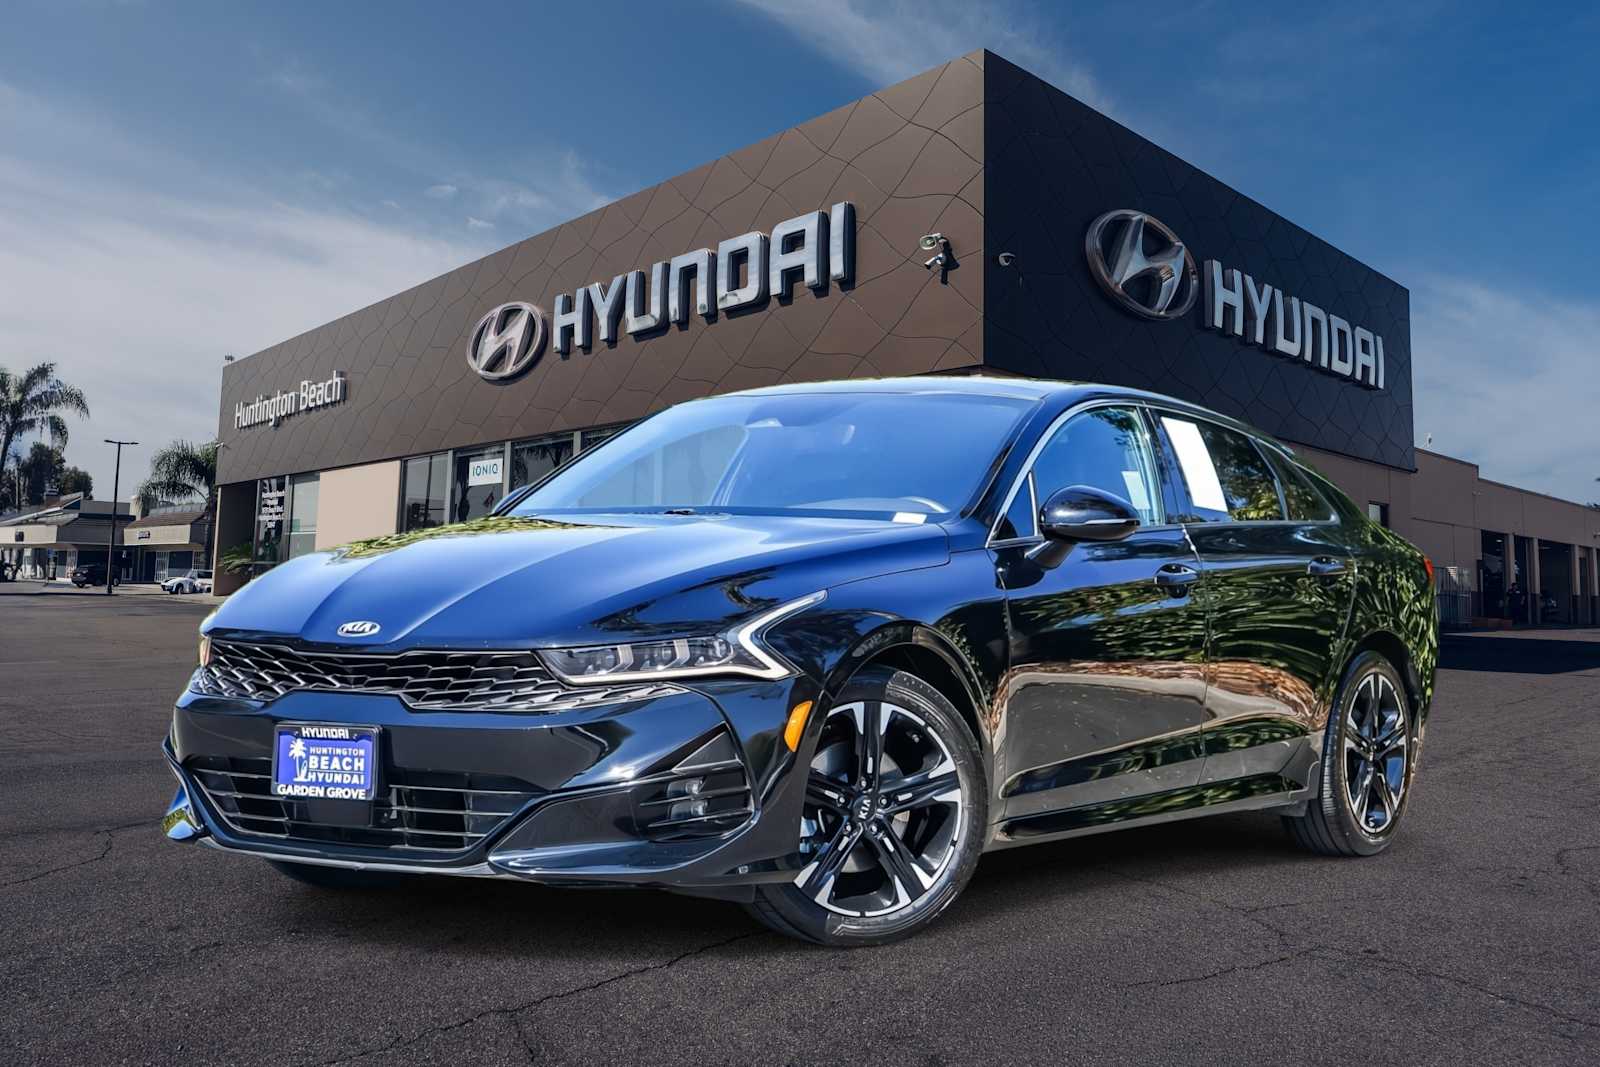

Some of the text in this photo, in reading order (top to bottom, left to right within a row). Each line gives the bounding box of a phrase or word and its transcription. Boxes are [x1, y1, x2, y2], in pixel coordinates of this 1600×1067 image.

[553, 201, 855, 355] HYUNDAI
[1204, 259, 1385, 390] HYUNDAI
[234, 370, 344, 429] Huntington Beach
[472, 463, 499, 477] IONIQ
[301, 727, 350, 740] HYUNDAI
[309, 746, 365, 756] HUNTINGTON
[308, 755, 365, 771] BEACH
[308, 772, 364, 785] HYUNDAI
[277, 784, 366, 799] GARDEN GROVE
[858, 799, 871, 820] KIA
